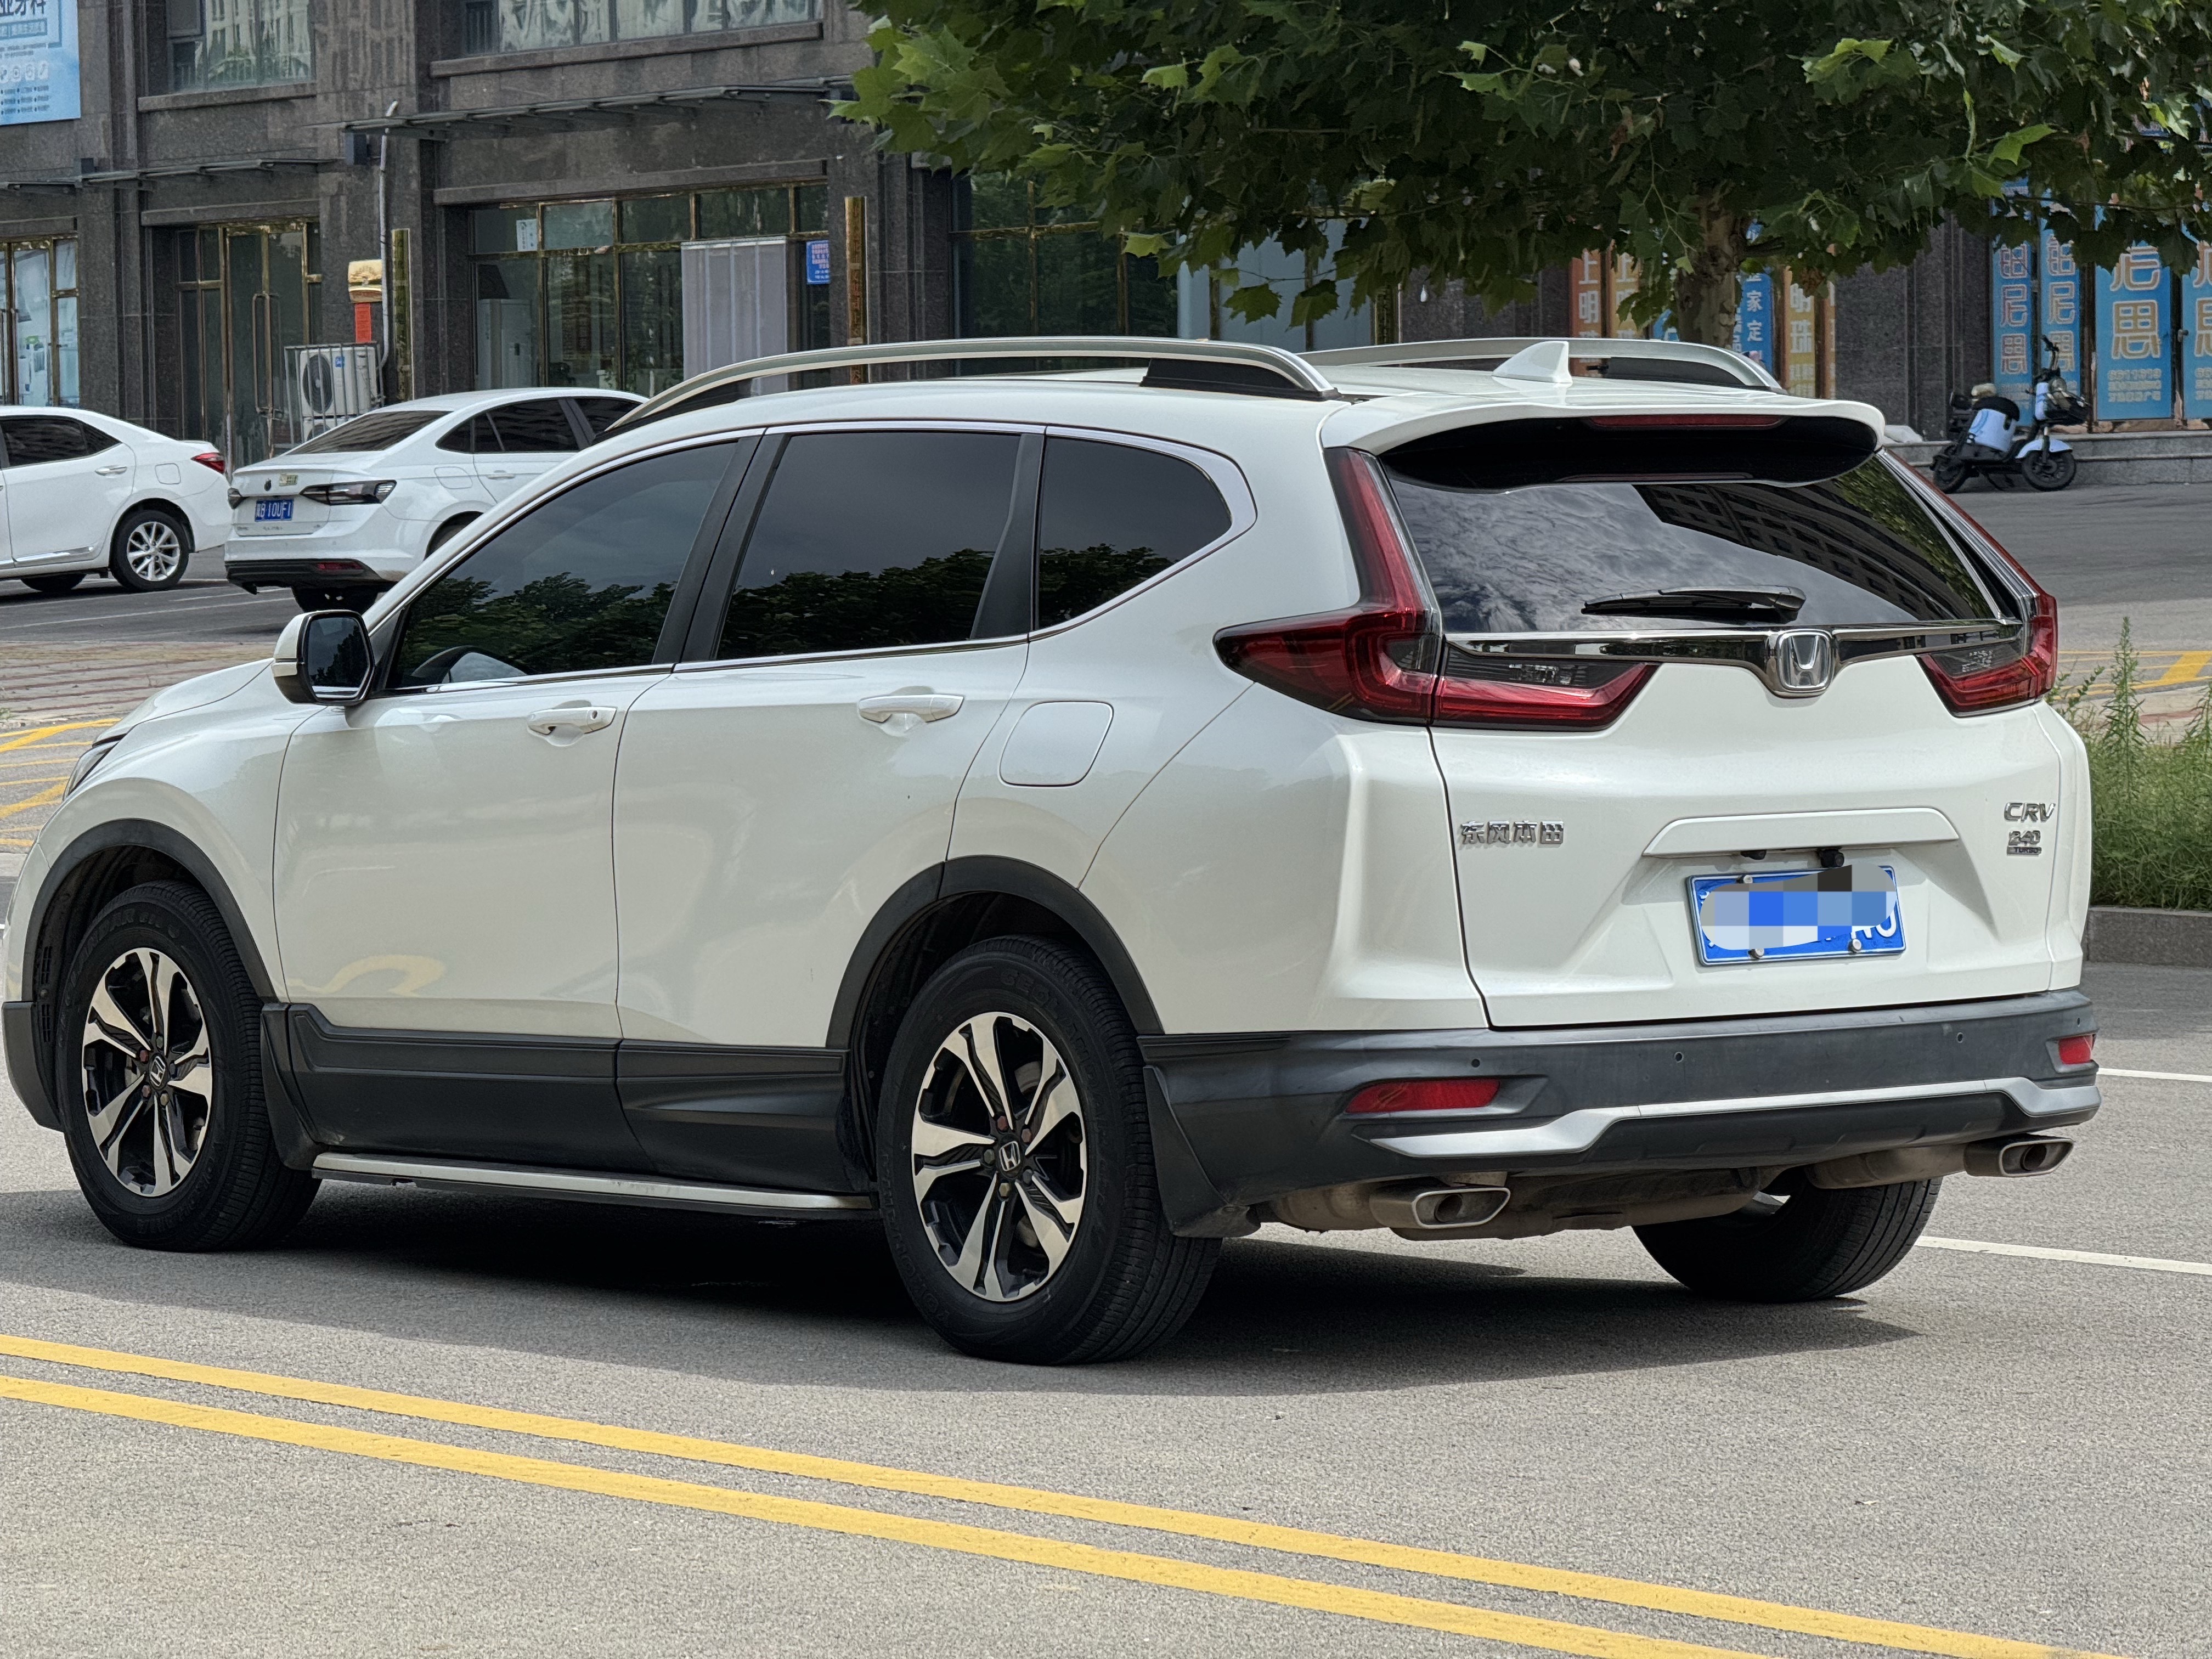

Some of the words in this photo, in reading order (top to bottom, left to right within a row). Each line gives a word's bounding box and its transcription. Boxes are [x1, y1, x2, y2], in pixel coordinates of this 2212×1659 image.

[1746, 273, 1763, 359] 家定
[1461, 820, 1564, 845] 东风本田
[2008, 830, 2041, 845] 240
